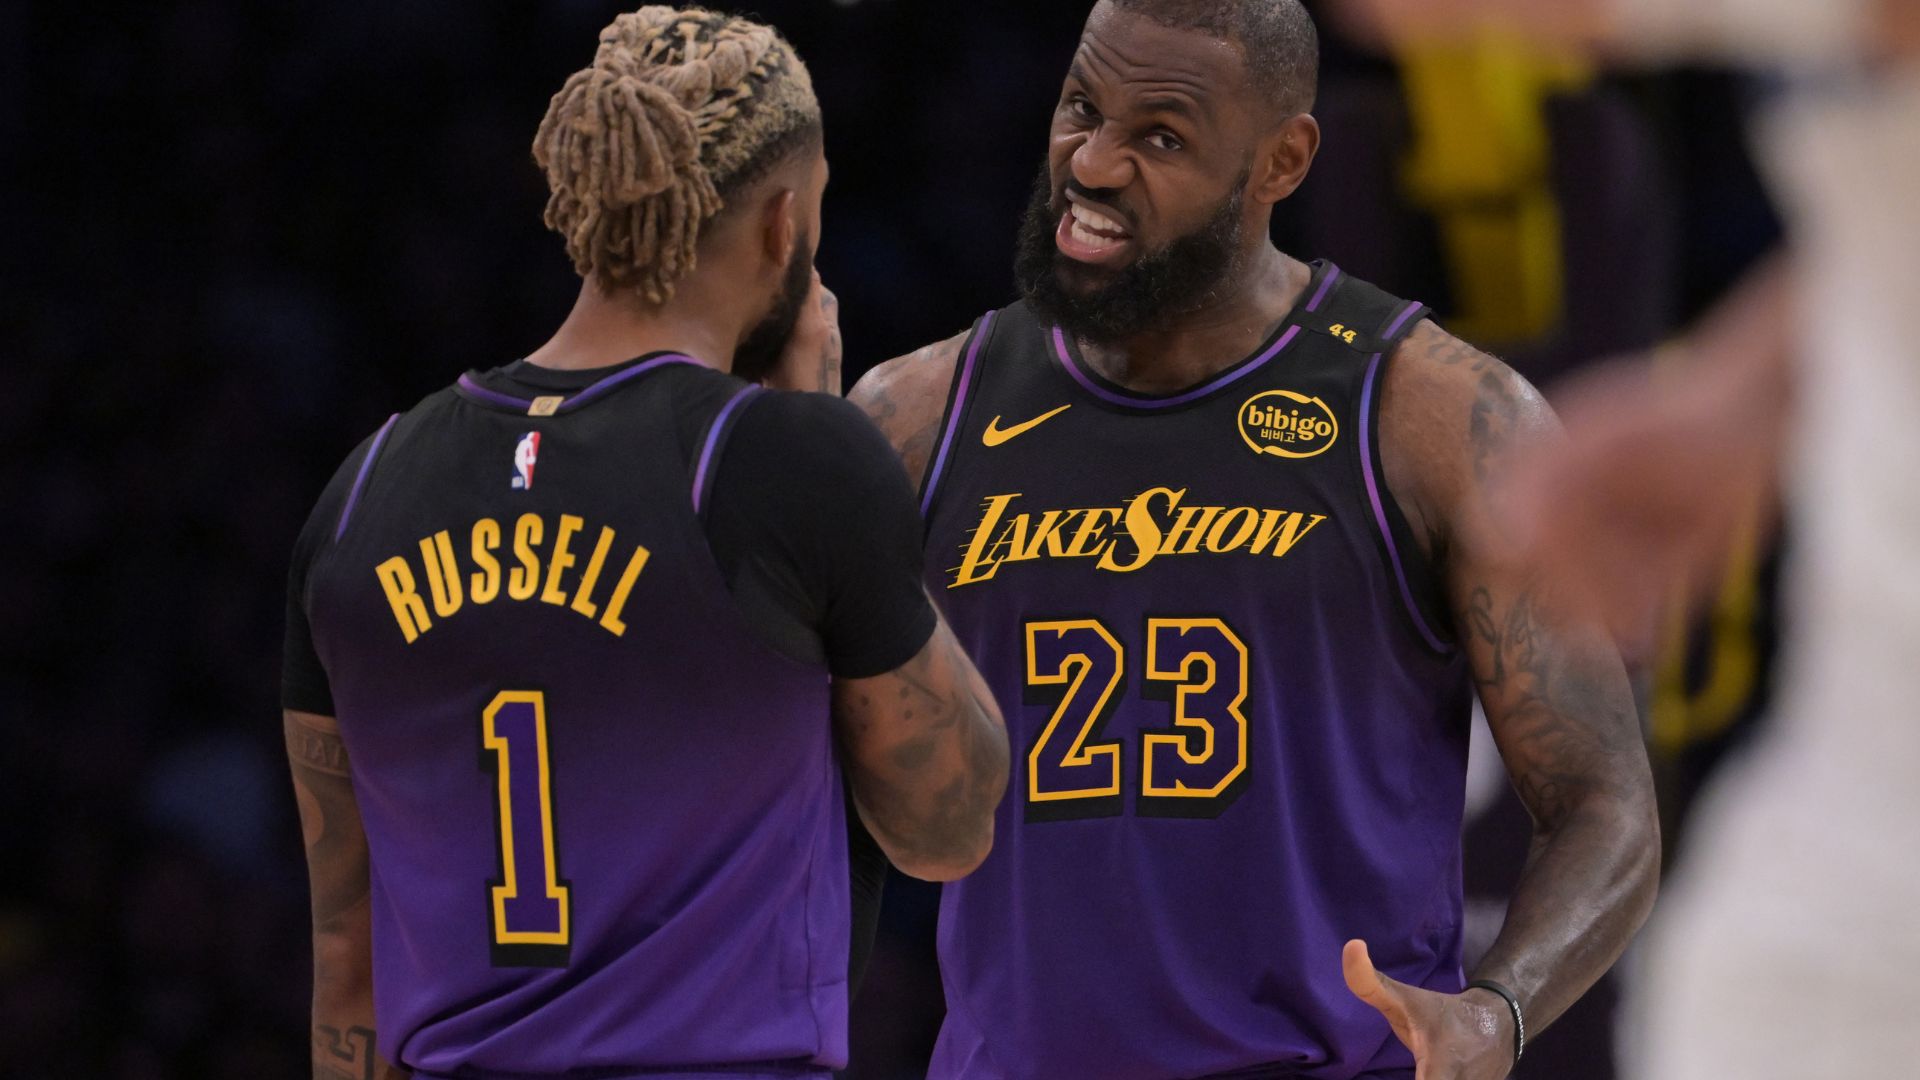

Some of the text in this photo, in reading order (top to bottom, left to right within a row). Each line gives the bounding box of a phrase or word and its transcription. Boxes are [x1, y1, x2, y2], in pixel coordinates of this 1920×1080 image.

[1328, 323, 1358, 345] 44
[1247, 404, 1332, 441] bibigo
[1260, 428, 1296, 443] 비비고
[374, 512, 651, 645] RUSSELL
[1024, 617, 1248, 803] 23
[482, 690, 569, 946] 1
